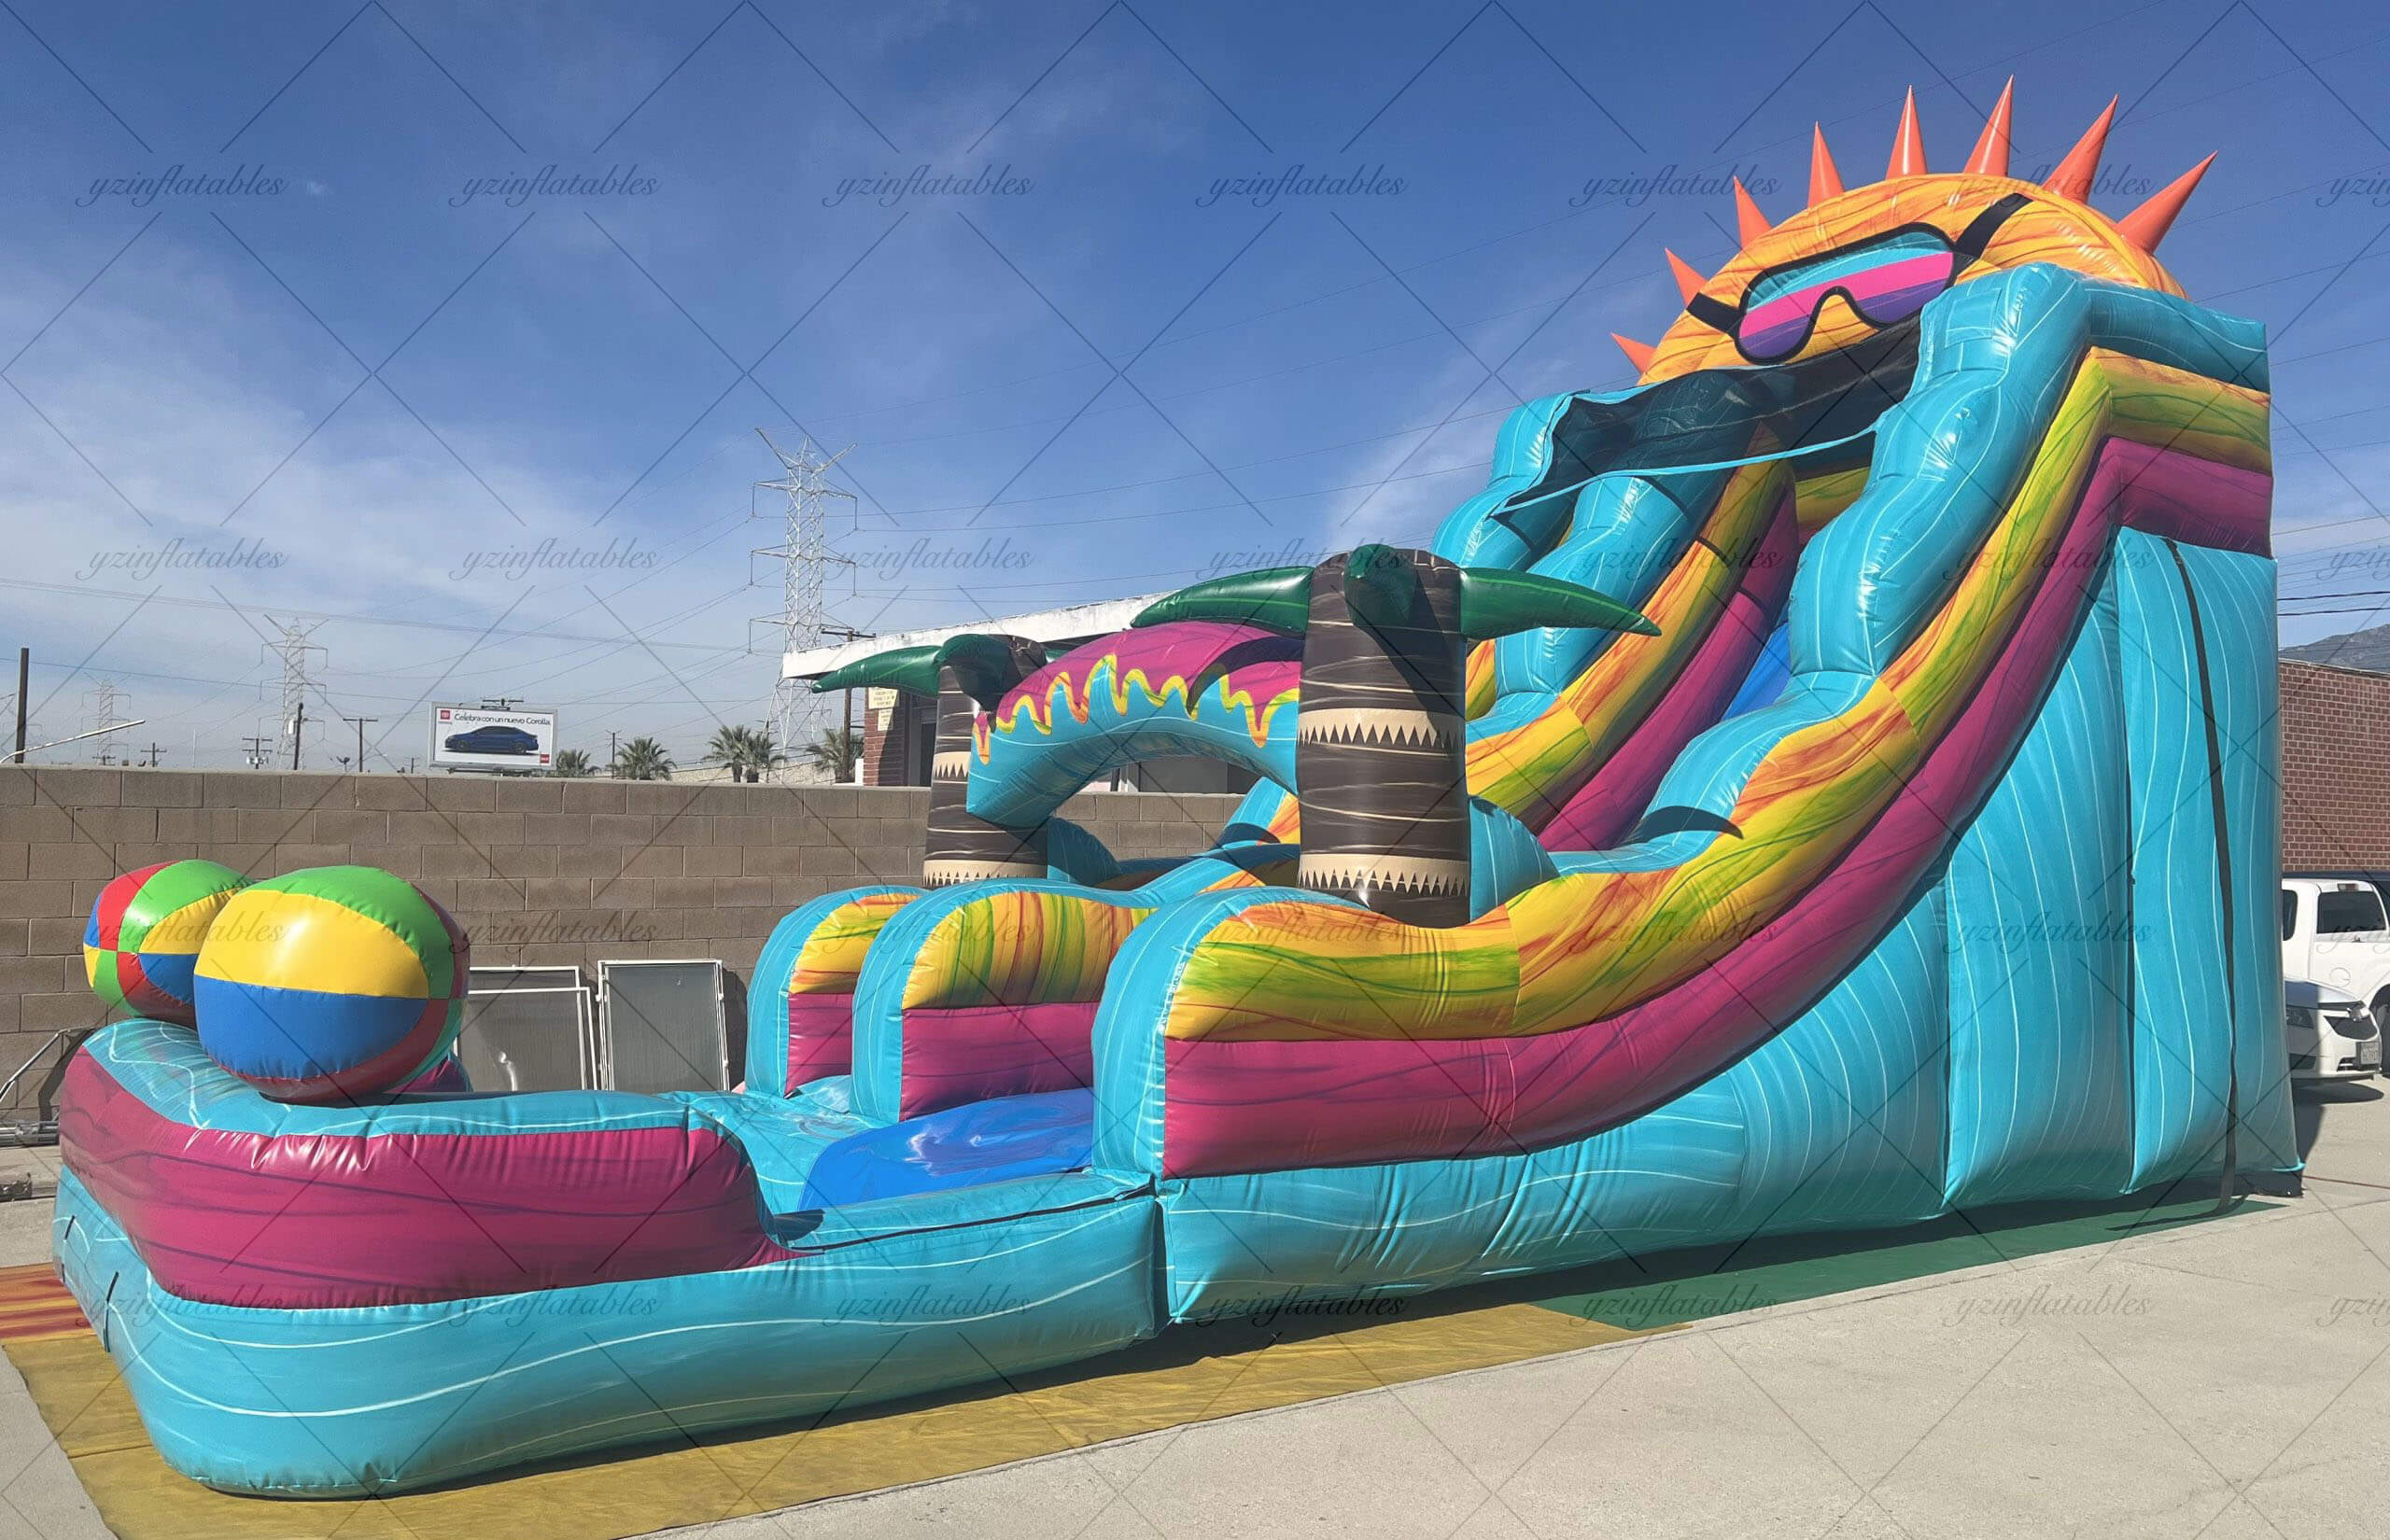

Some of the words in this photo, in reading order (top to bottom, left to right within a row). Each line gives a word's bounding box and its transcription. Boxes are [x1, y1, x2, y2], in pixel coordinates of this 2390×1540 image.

[454, 711, 481, 722] Celebra
[504, 717, 525, 725] nuevo
[526, 716, 552, 726] Corolla
